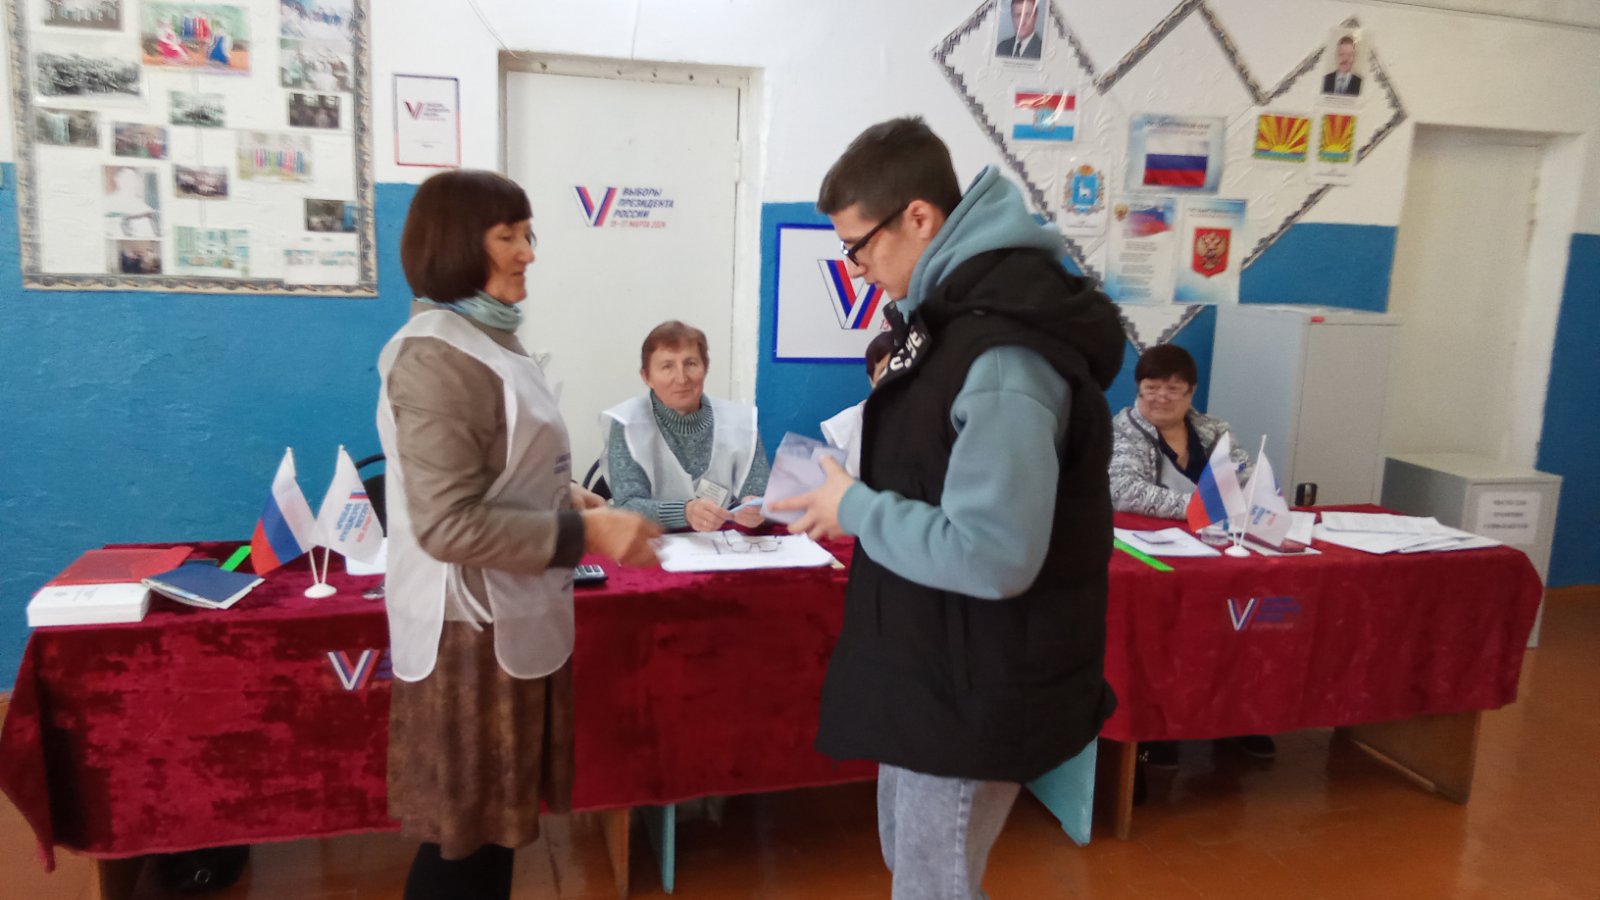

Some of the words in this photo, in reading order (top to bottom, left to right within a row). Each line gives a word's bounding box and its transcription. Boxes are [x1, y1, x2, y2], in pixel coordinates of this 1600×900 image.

[622, 187, 662, 196] ВЫБОРЫ
[618, 199, 674, 208] ПРЕЗИДЕНТА
[613, 210, 651, 218] РОССИИ
